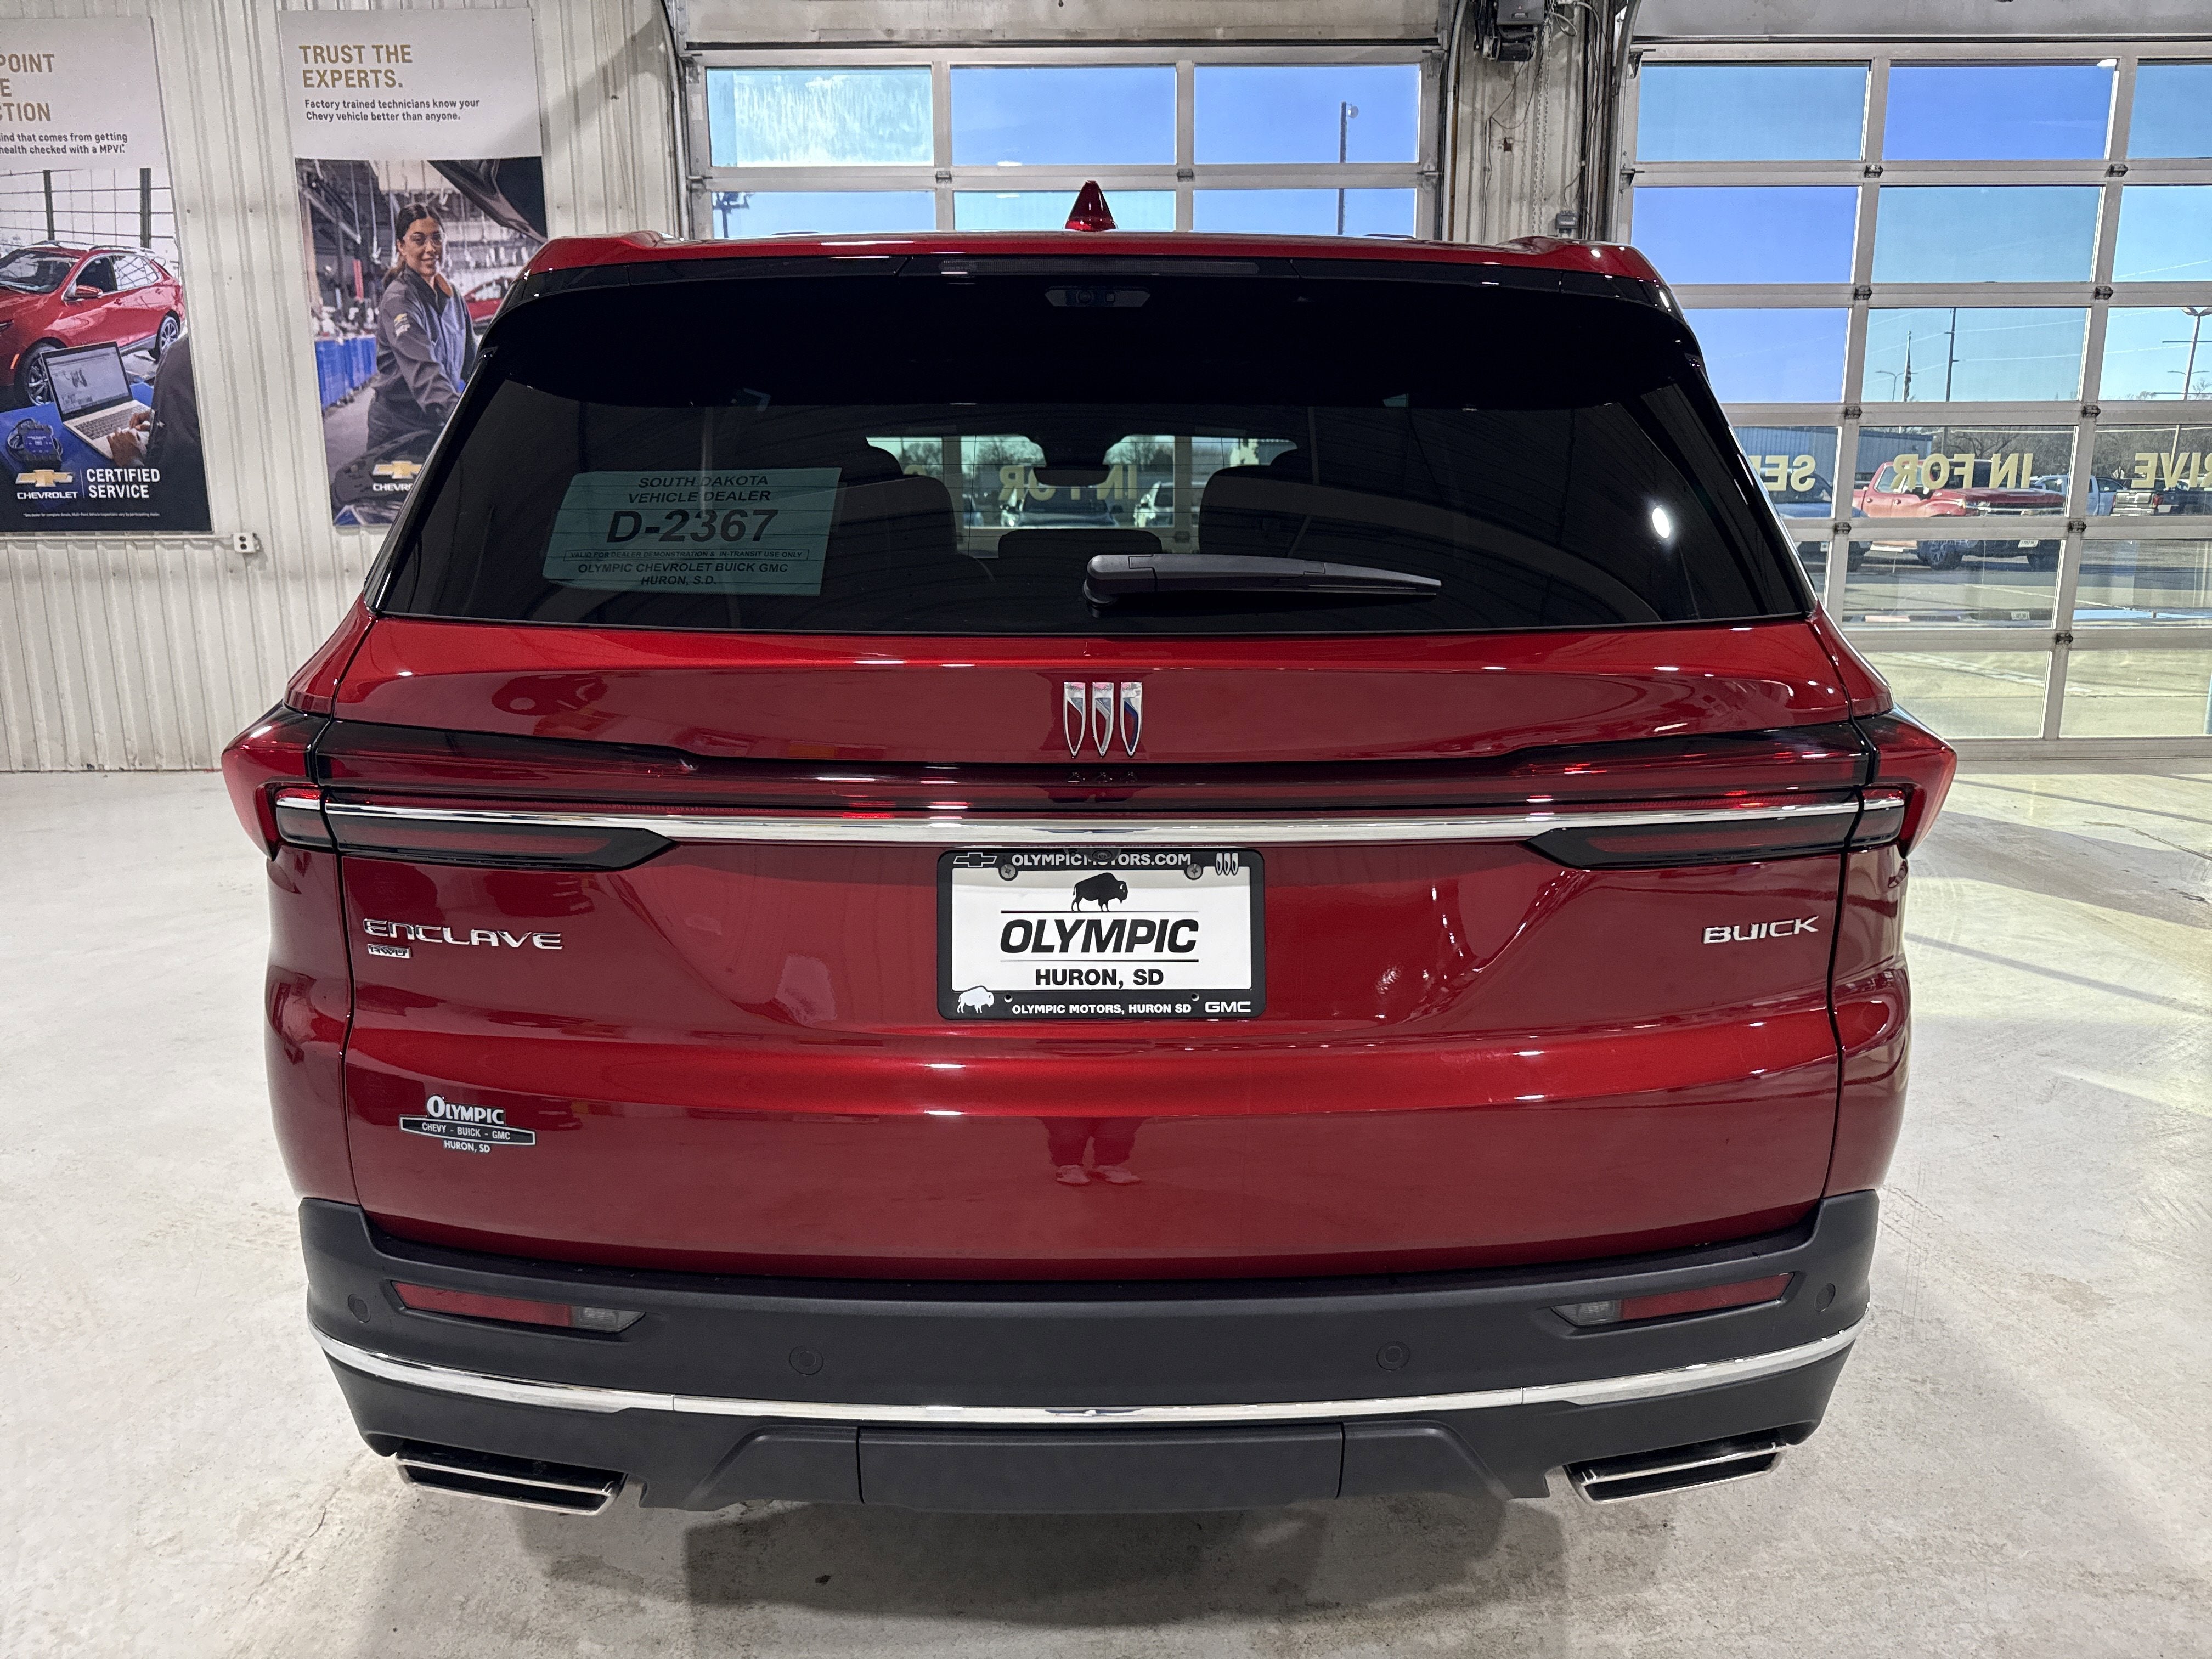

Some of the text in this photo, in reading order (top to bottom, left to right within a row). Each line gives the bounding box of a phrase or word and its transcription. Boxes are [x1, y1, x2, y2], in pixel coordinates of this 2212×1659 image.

[299, 44, 413, 64] TRUST THE
[303, 70, 403, 88] EXPERTS.
[305, 98, 480, 110] Factory trained technicians know your
[0, 103, 51, 122] TION
[306, 111, 461, 122] Chevy vehicle better than anyone.
[16, 132, 37, 142] that
[39, 134, 68, 142] comes
[70, 132, 92, 142] from
[94, 132, 128, 143] getting
[30, 145, 67, 154] checked
[69, 144, 89, 154] with
[86, 468, 160, 483] CERTIFIED
[639, 476, 769, 488] SOUTH DAKOTA
[16, 491, 78, 500] CHEVROLET
[88, 484, 150, 499] SERVICE
[628, 490, 771, 503] VEHICLE DEALER
[607, 509, 779, 543] D-2367
[578, 562, 788, 573] OLYMPIC CHEVROLET BUICK GMC
[641, 575, 718, 586] HURON, S.D.
[1012, 853, 1192, 866] OLYMPICORS.COM
[363, 918, 563, 950] ENCLAVE
[1000, 919, 1199, 953] OLYMPIC
[1702, 915, 1819, 944] BUICK
[368, 944, 408, 957] AWD
[1035, 969, 1164, 989] HURON, SD
[1012, 1001, 1251, 1015] OLYMPIC MOTORS, HURON SD GMC
[427, 1096, 504, 1125] OLYMPIC
[422, 1122, 447, 1133] CHEVY
[456, 1126, 481, 1137] BUICK
[492, 1130, 511, 1140] GMC
[444, 1140, 491, 1153] HURON, SD
